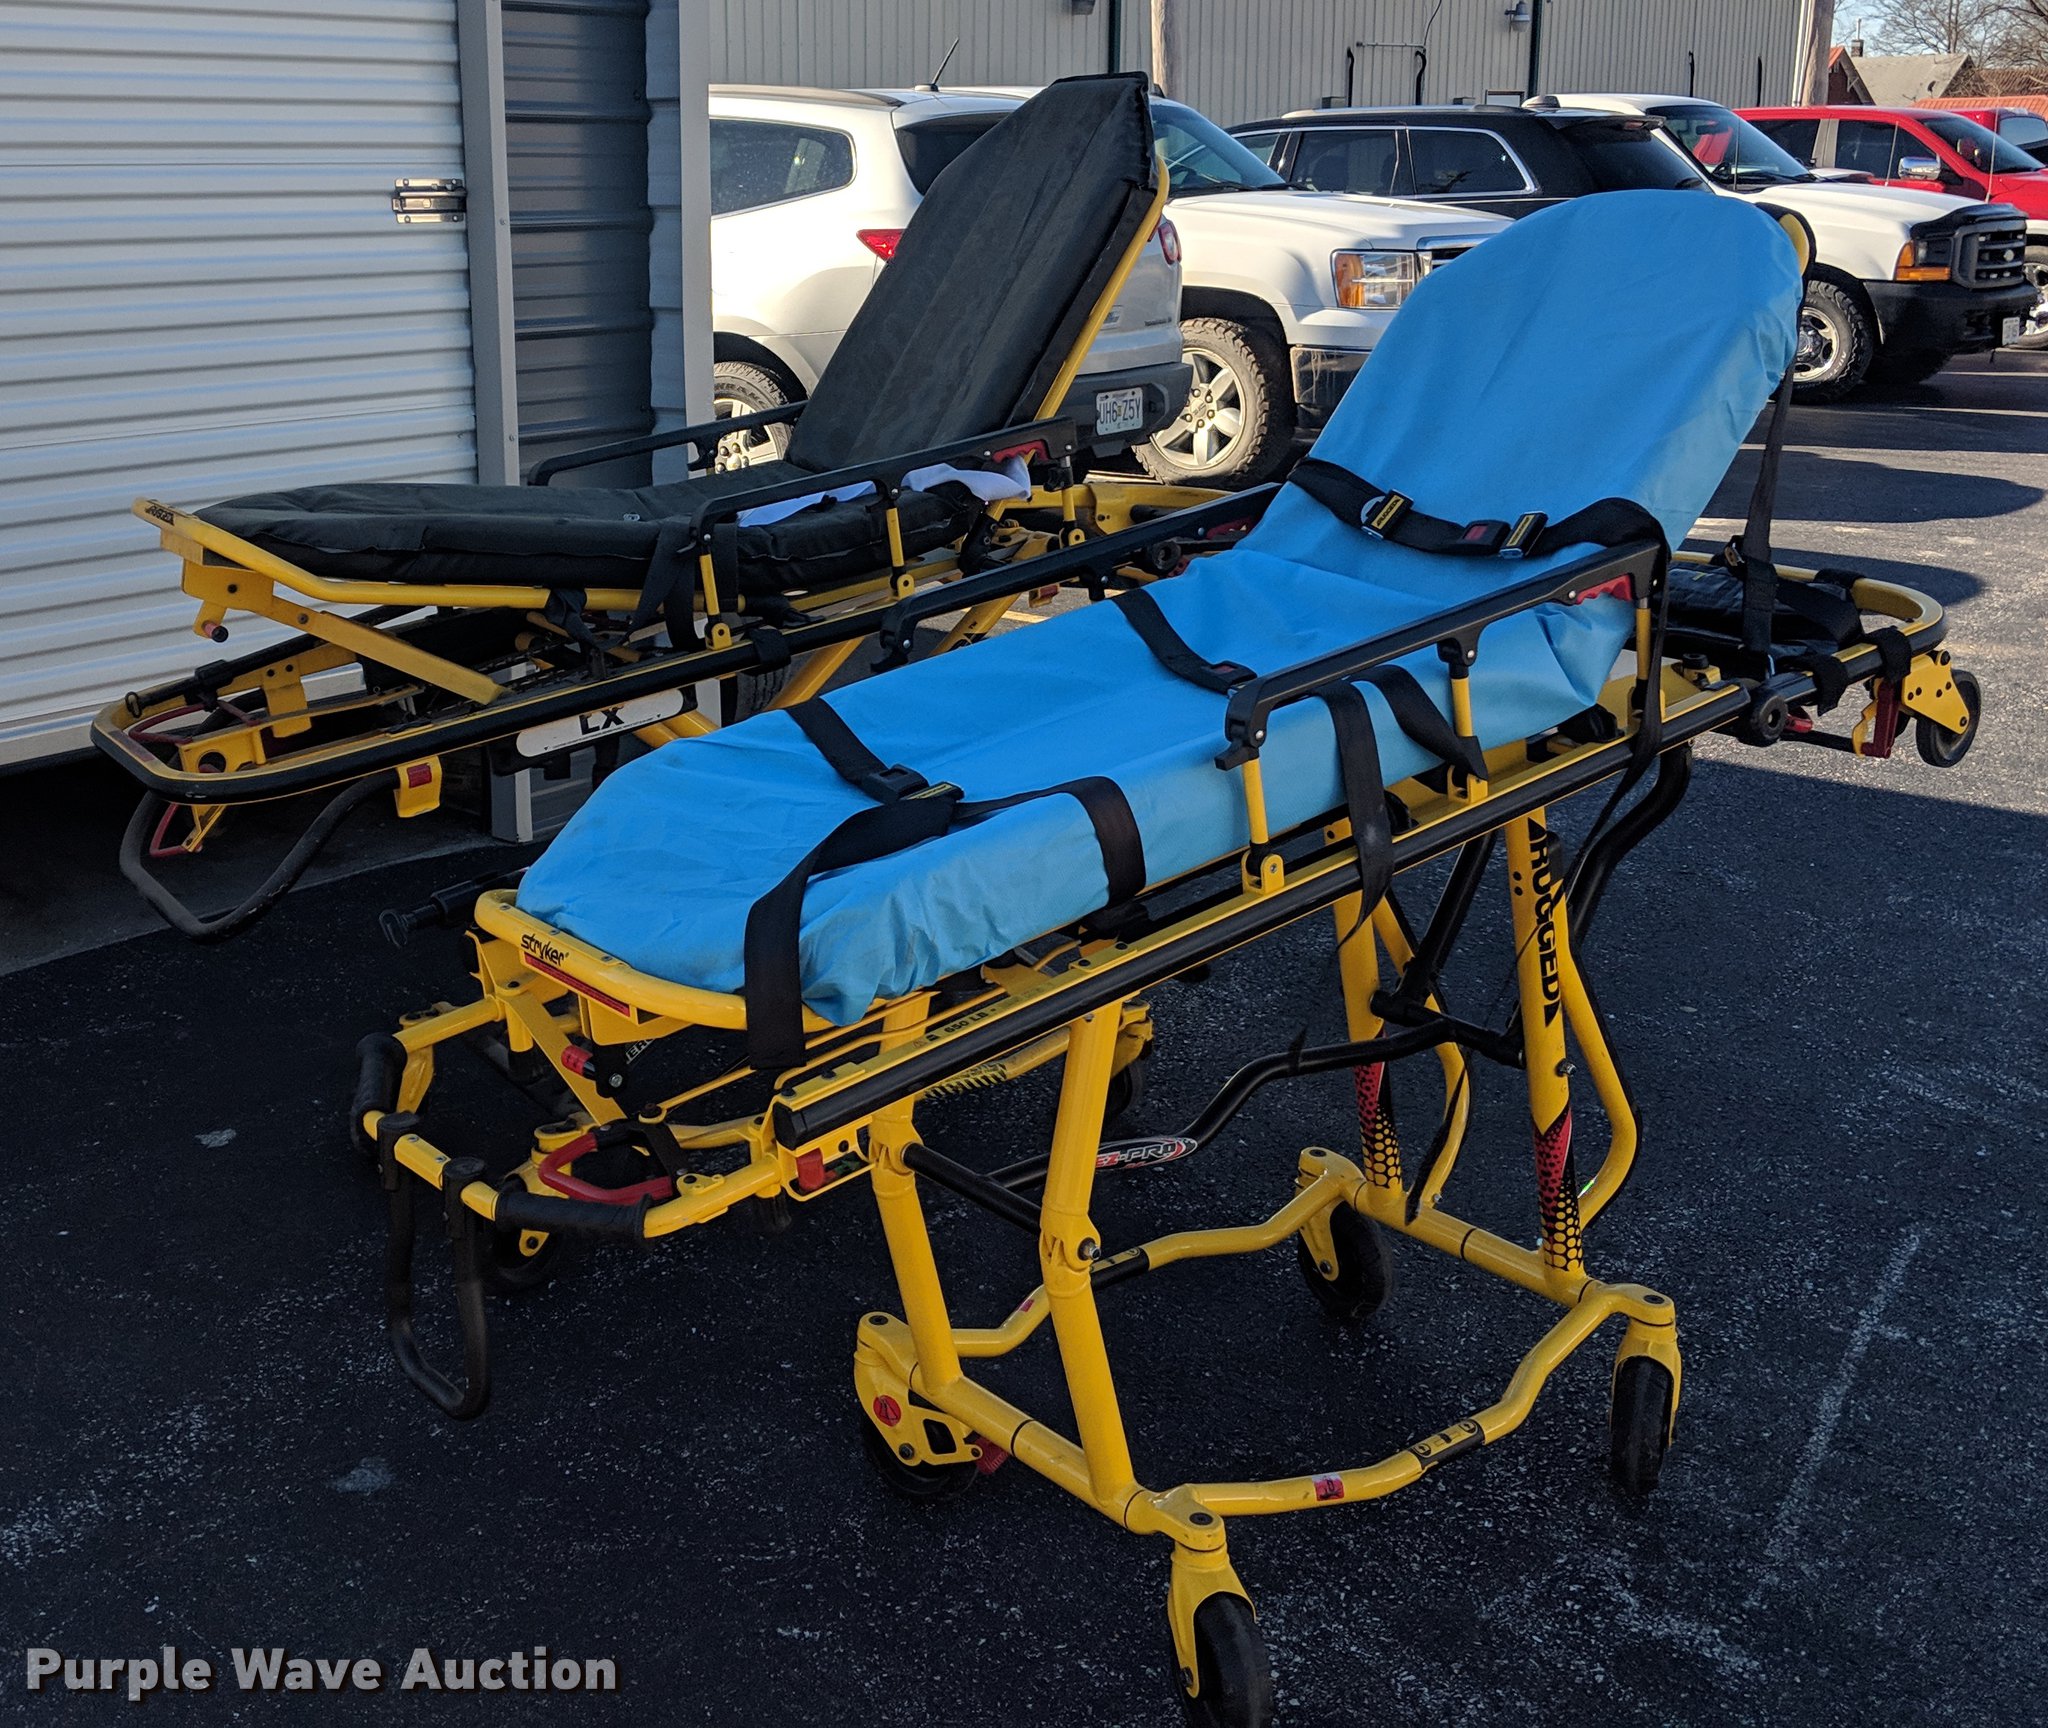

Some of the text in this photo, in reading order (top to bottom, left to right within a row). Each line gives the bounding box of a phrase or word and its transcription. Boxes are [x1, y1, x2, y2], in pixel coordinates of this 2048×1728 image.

[1122, 397, 1141, 421] Z5Y
[1529, 835, 1563, 1002] RUGGED
[521, 933, 567, 967] stryker
